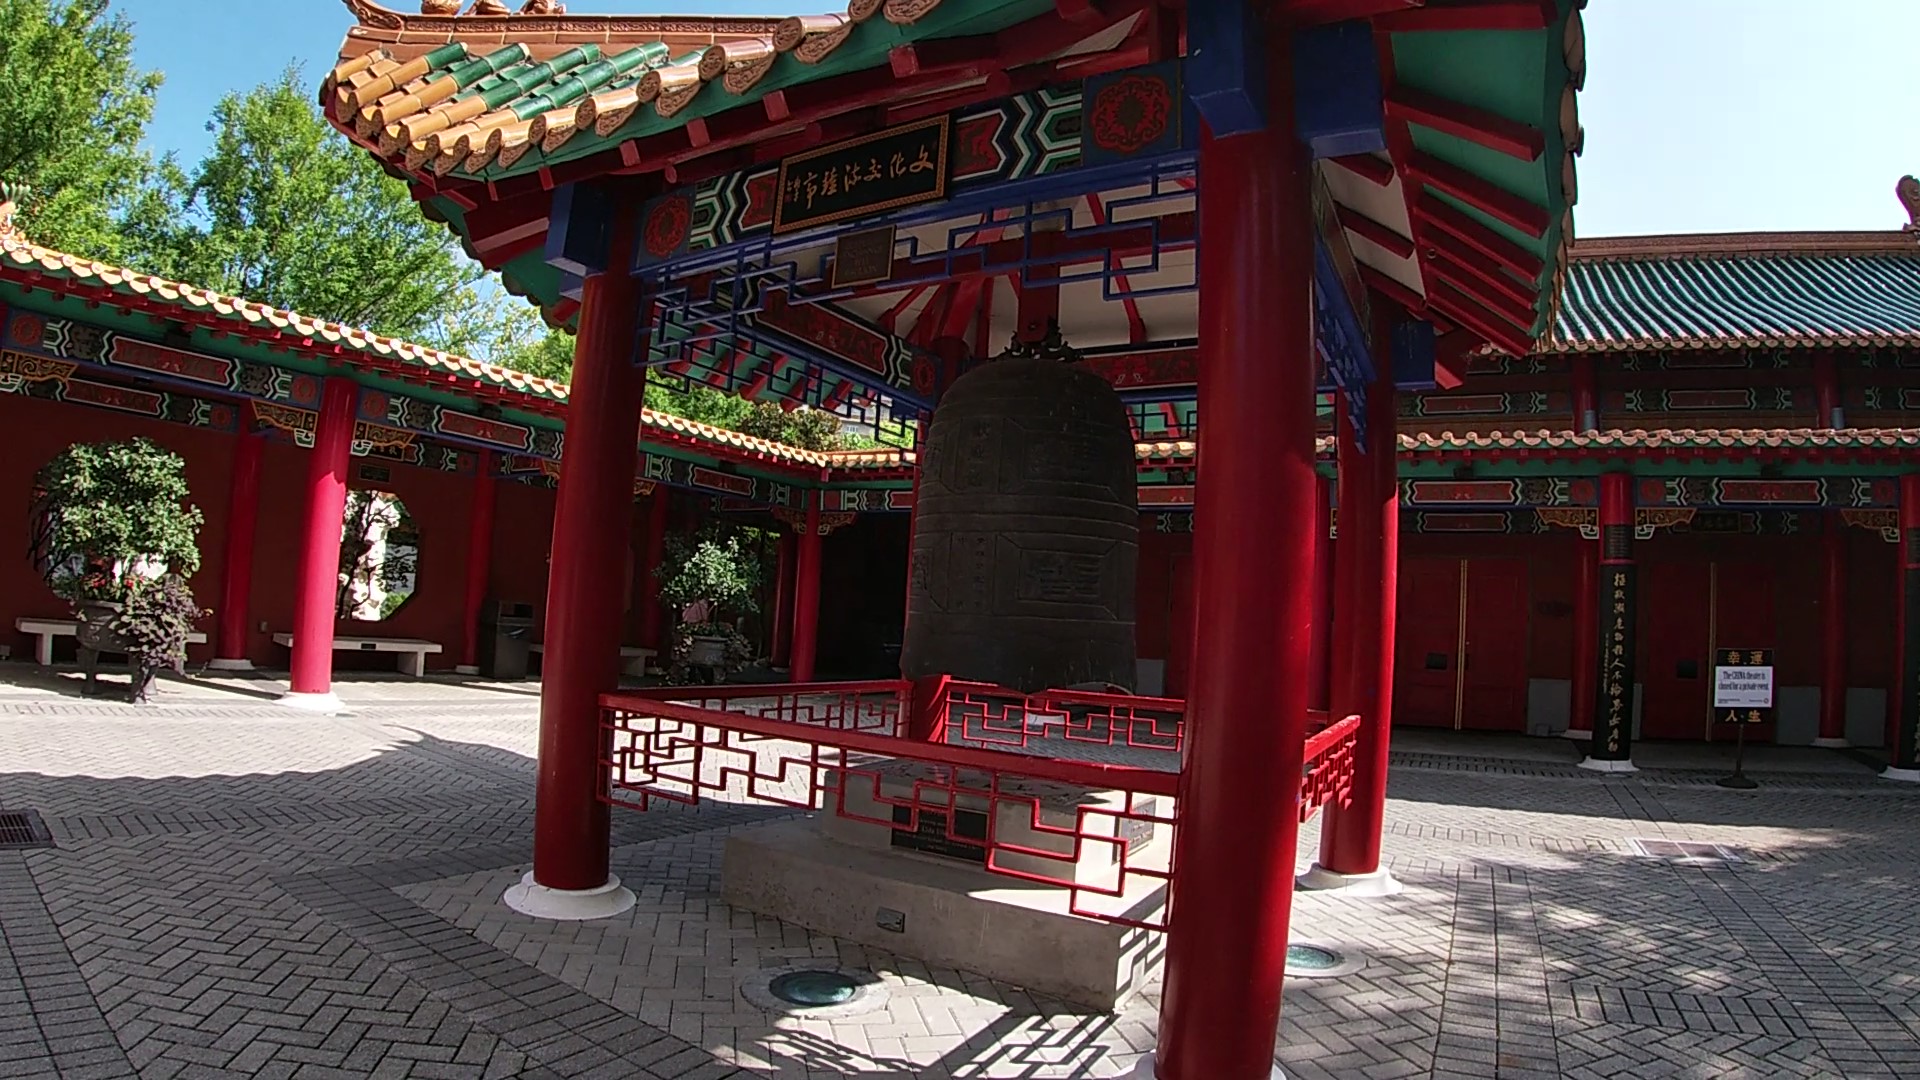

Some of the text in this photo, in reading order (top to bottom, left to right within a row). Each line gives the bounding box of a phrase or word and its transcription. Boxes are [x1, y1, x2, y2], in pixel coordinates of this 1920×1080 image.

[1723, 671, 1731, 679] The
[1732, 671, 1745, 680] CHINA
[1718, 682, 1731, 690] closed
[1742, 682, 1756, 691] private
[1725, 709, 1761, 722] 人生
